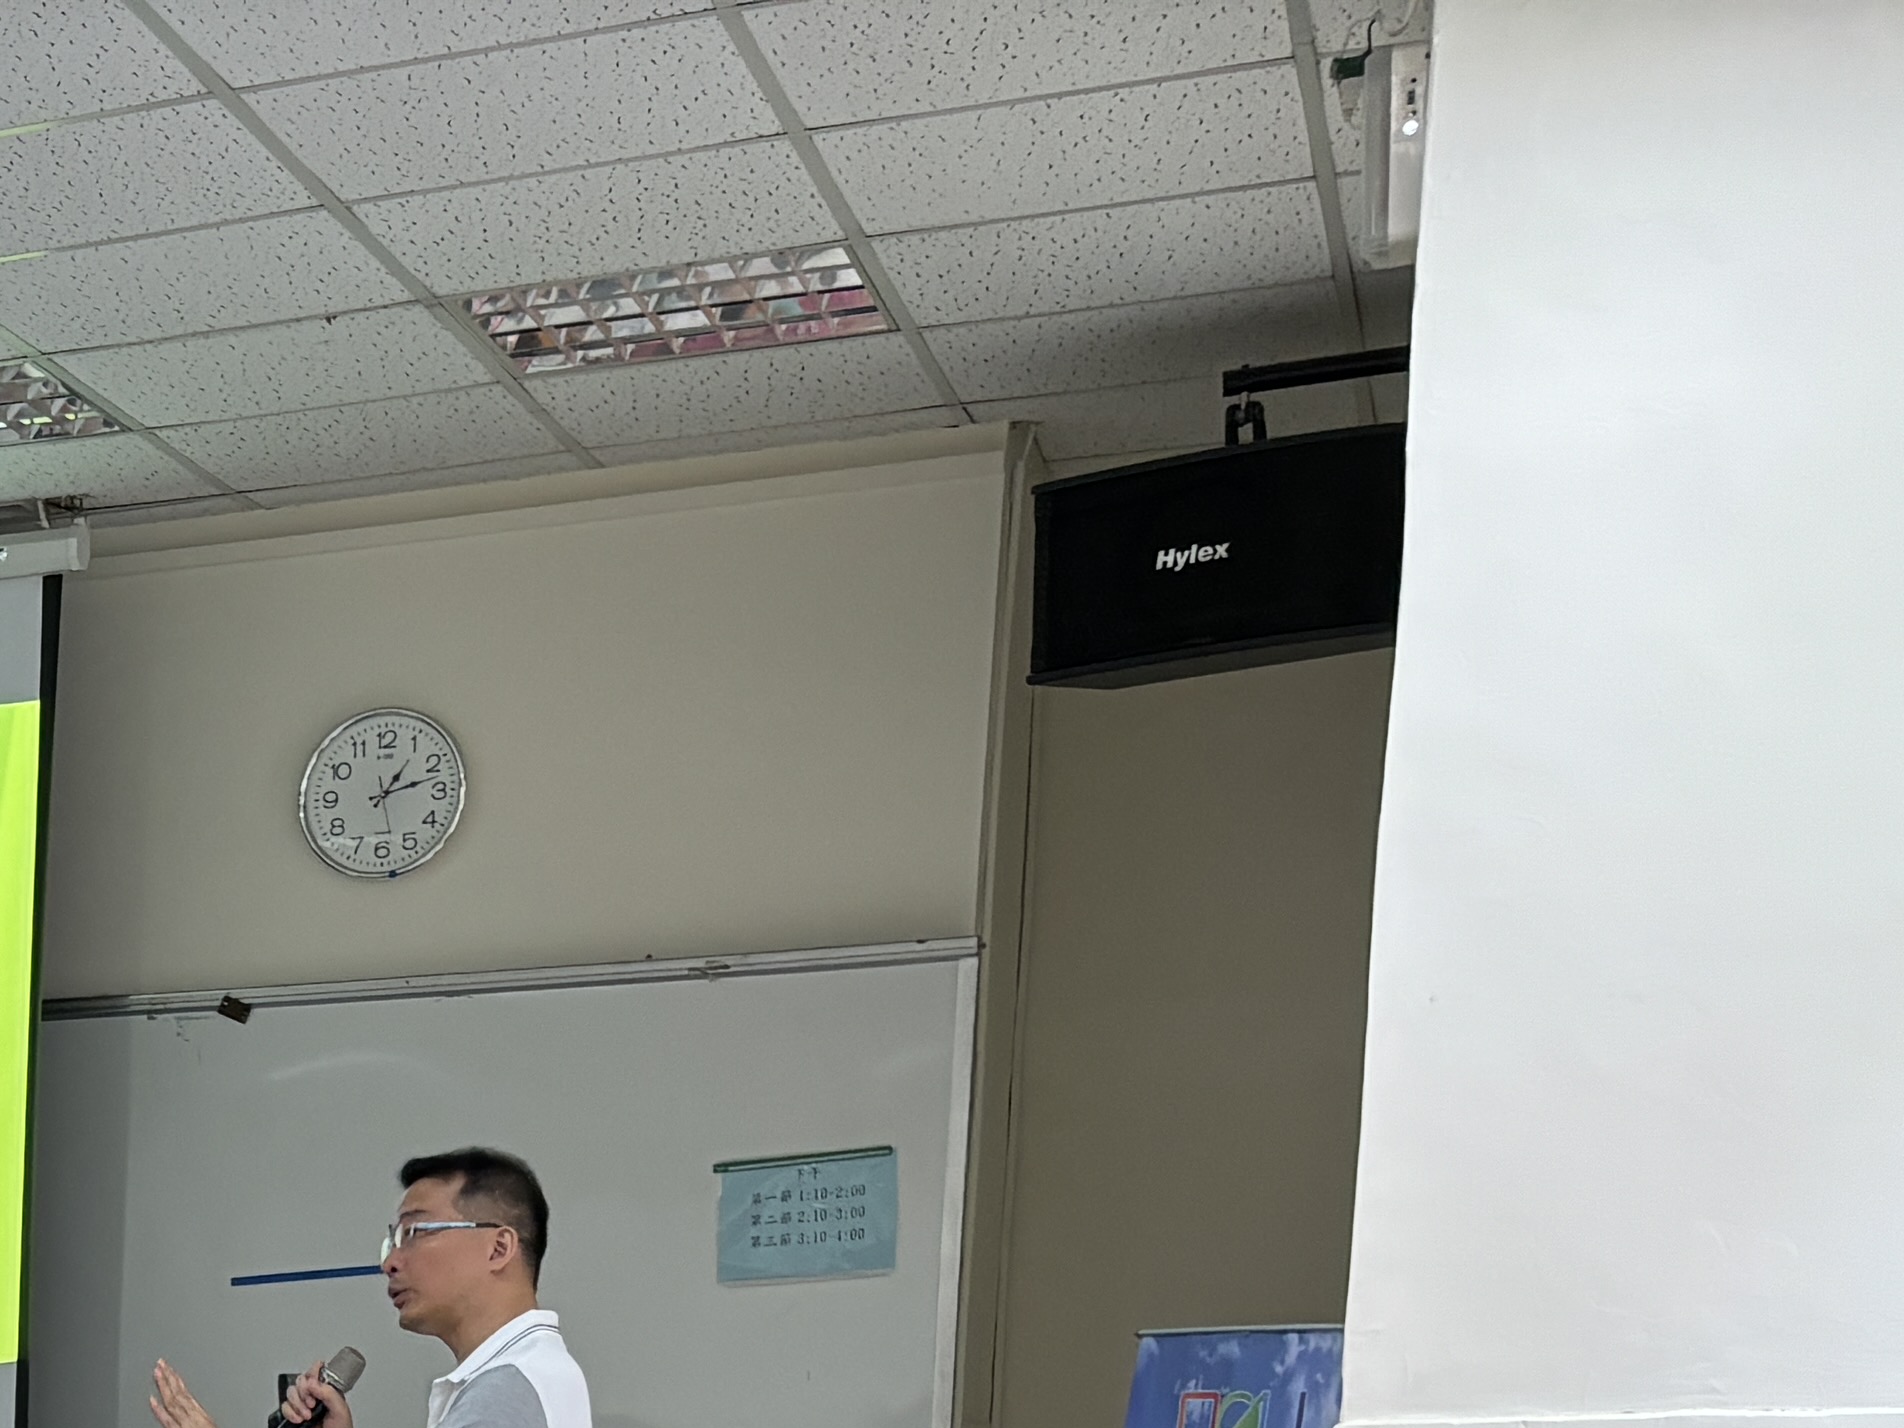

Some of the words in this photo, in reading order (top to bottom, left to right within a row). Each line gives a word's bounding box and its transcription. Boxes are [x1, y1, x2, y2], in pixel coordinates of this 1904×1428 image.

[1155, 540, 1231, 572] Hylex
[352, 739, 366, 759] 11
[376, 730, 397, 749] 12
[411, 735, 417, 753] 1
[331, 762, 352, 781] 10
[425, 753, 441, 774] 2
[322, 791, 339, 809] 9
[430, 781, 447, 800] 3
[330, 817, 345, 836] 8
[421, 810, 438, 829] 4
[349, 836, 364, 855] 7
[374, 841, 390, 859] 6
[402, 832, 418, 850] 5
